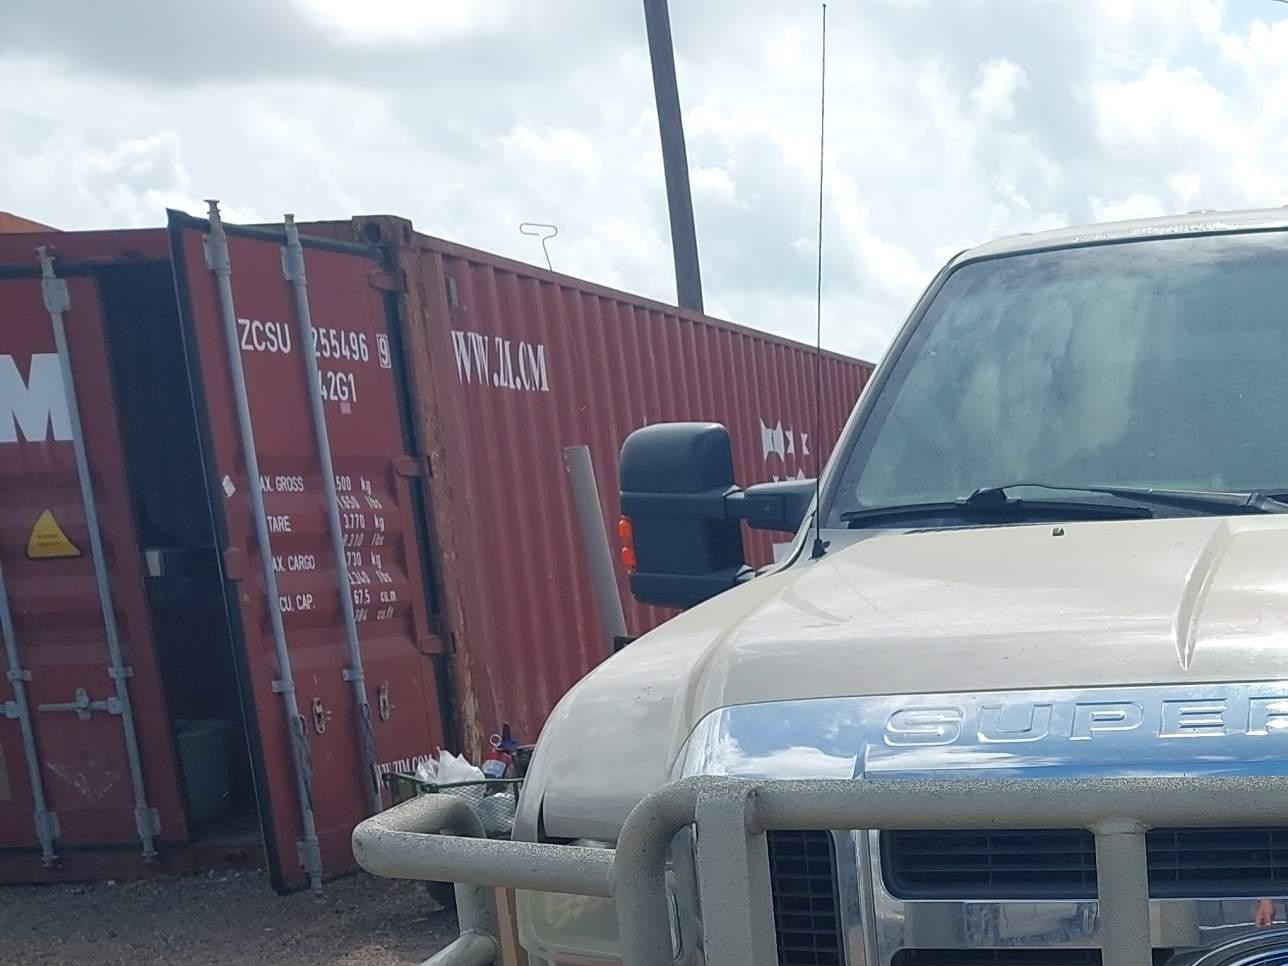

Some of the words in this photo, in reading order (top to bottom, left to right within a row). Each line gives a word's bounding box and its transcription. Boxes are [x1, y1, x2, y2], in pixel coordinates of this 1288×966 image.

[238, 318, 292, 354] ZCSU
[311, 326, 369, 362] 255496
[377, 336, 390, 367] 9
[275, 475, 305, 492] GROSS
[360, 475, 372, 496] kg
[266, 515, 292, 533] TARE
[373, 513, 386, 533] kg
[287, 554, 316, 572] CARGO
[370, 551, 382, 569] kg
[295, 593, 317, 611] CAP.
